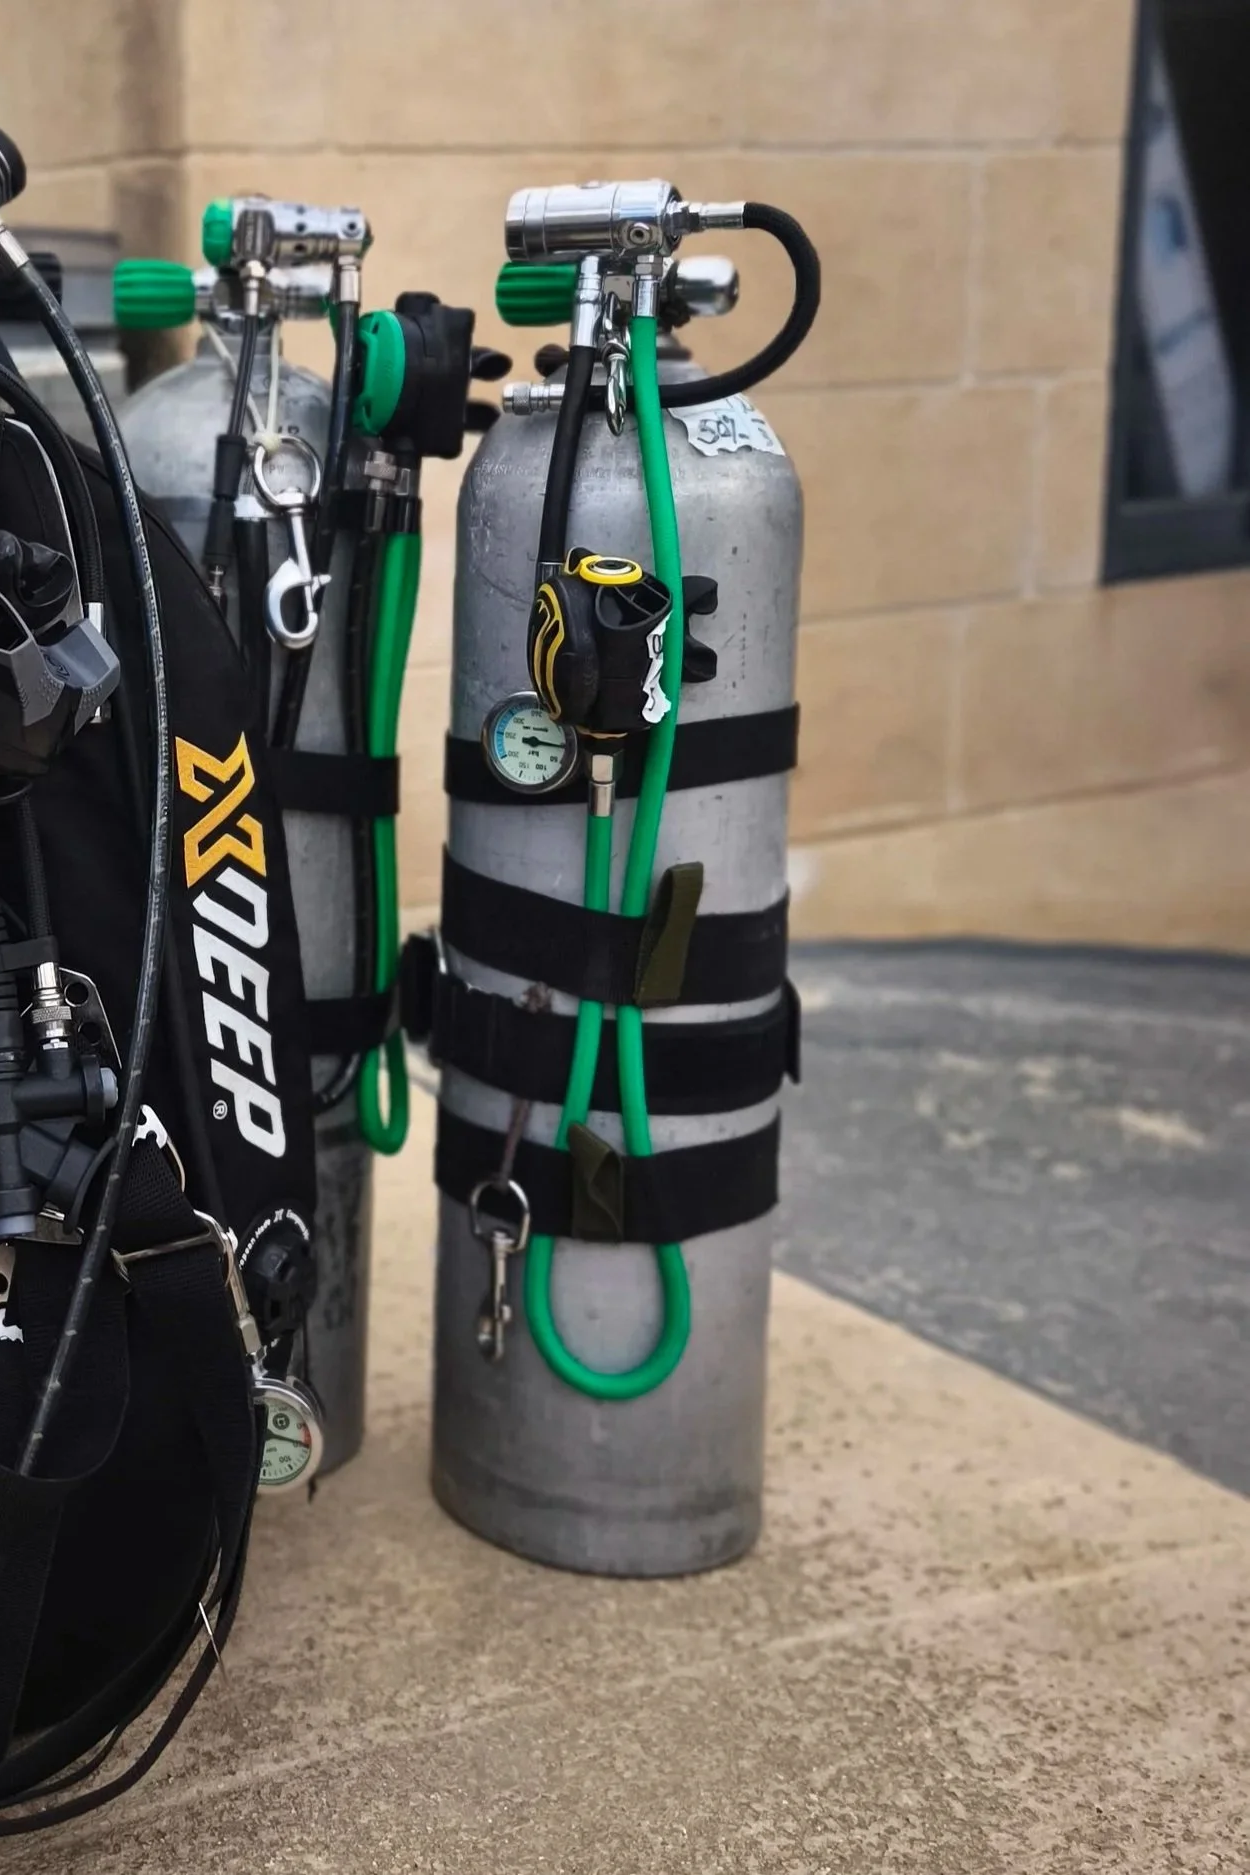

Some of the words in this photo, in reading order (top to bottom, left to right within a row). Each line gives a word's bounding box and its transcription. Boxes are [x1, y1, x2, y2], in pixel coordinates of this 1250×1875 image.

[505, 731, 516, 740] 250
[507, 750, 519, 758] 200
[549, 755, 558, 763] 50
[535, 763, 547, 771] 100
